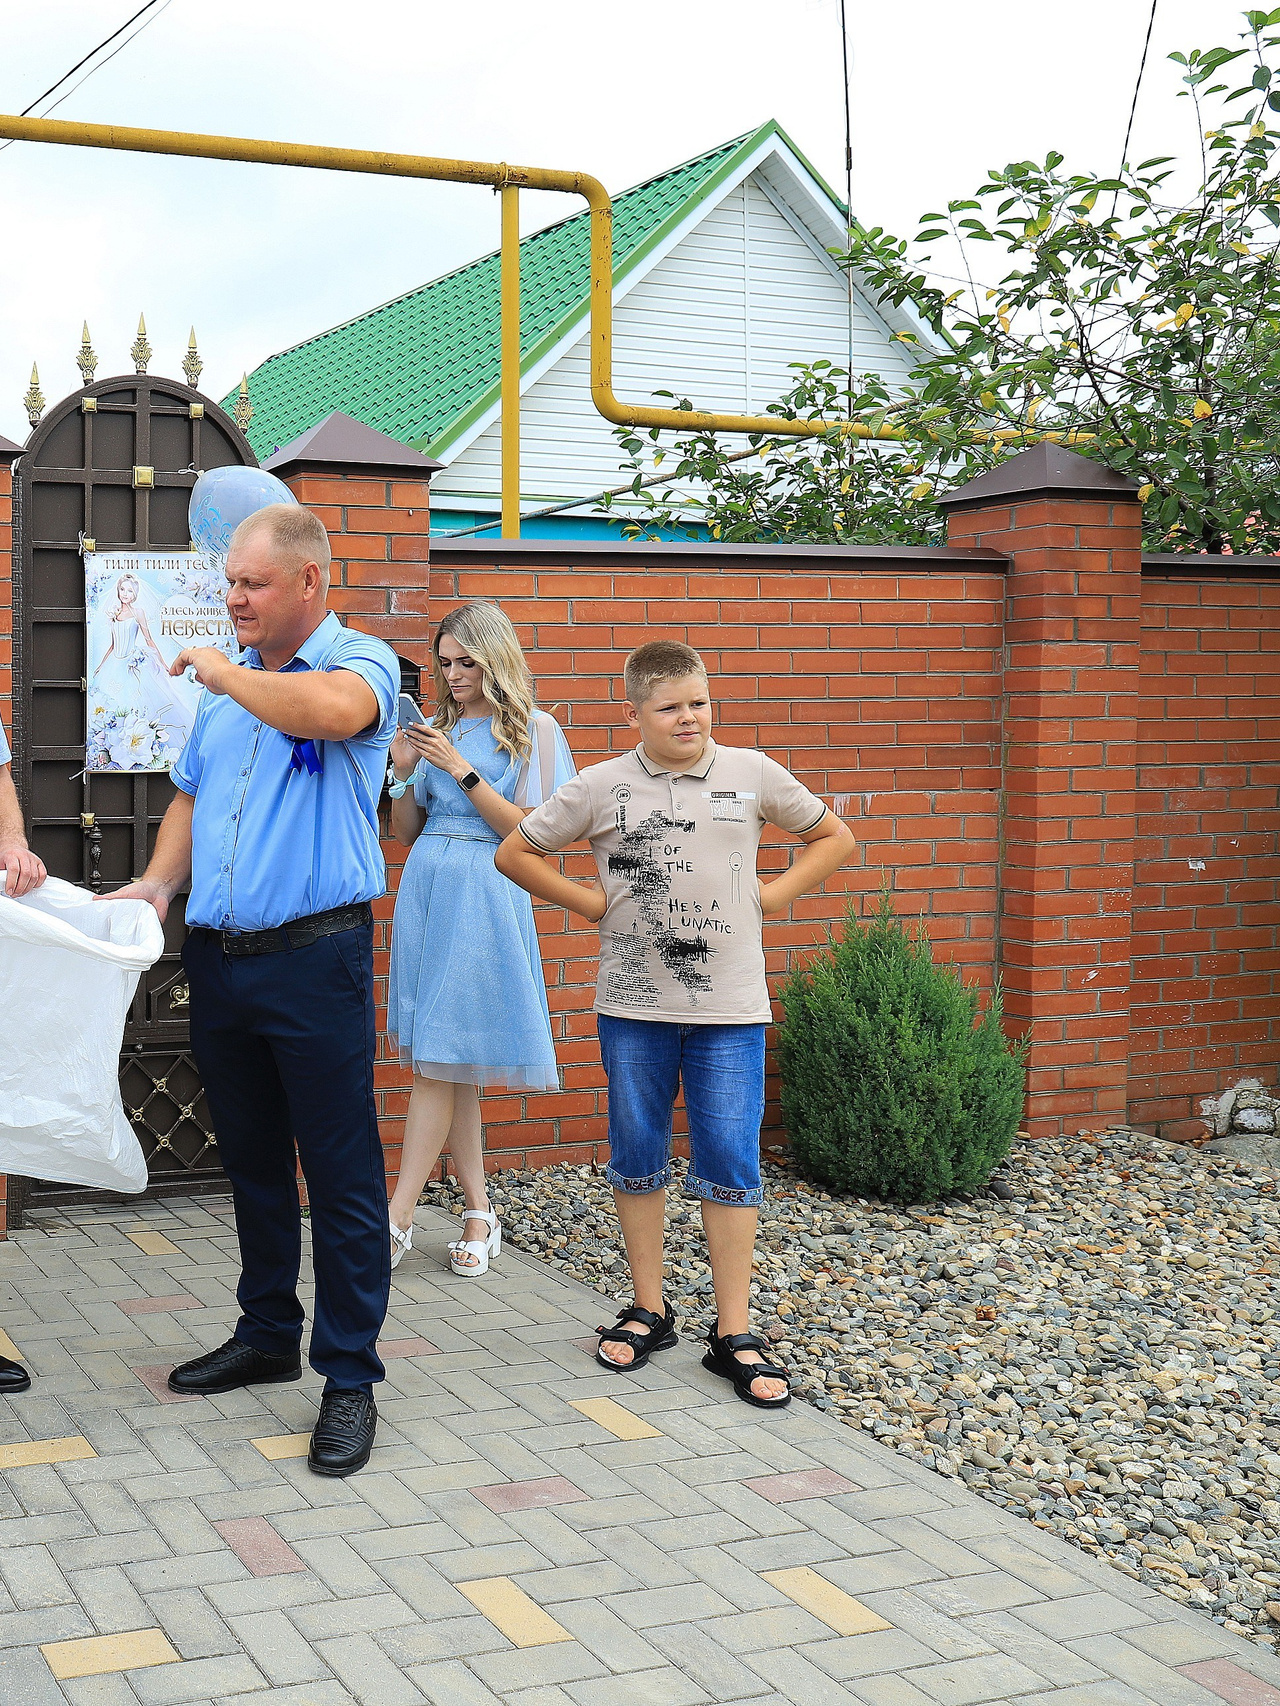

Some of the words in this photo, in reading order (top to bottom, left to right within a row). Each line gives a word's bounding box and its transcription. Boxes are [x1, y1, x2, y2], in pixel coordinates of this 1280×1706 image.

[161, 606, 194, 616] ЗДЕСЬ
[161, 619, 235, 639] НЕВЕСТА
[664, 844, 681, 855] OF
[663, 859, 694, 873] THE
[711, 899, 720, 911] A
